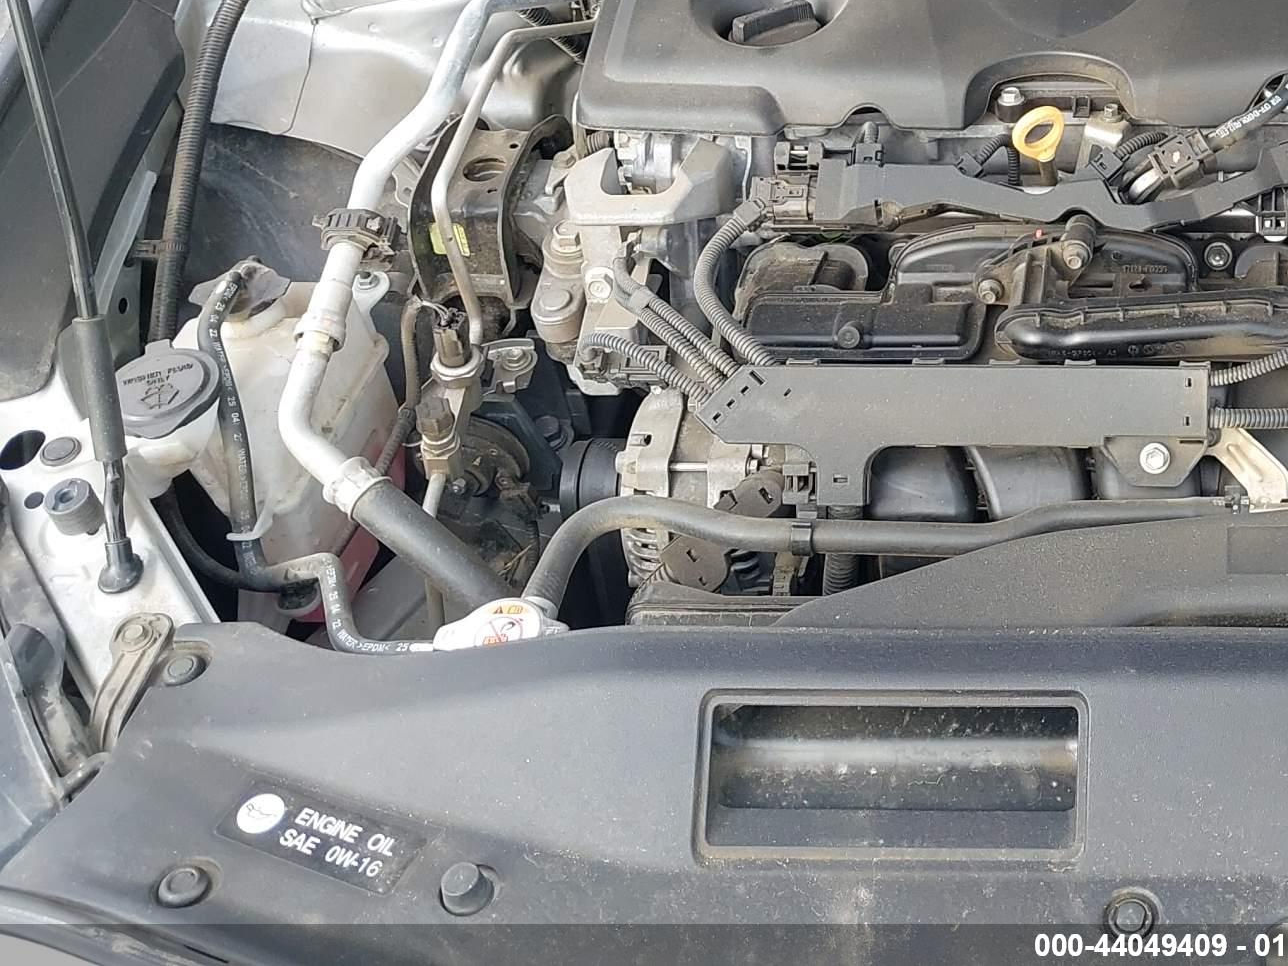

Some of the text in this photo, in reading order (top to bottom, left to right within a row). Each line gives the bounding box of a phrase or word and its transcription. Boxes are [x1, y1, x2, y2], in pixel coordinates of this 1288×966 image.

[395, 643, 409, 652] 25
[279, 828, 383, 878] SAE 0W-16
[294, 806, 396, 857] ENGINE OIL
